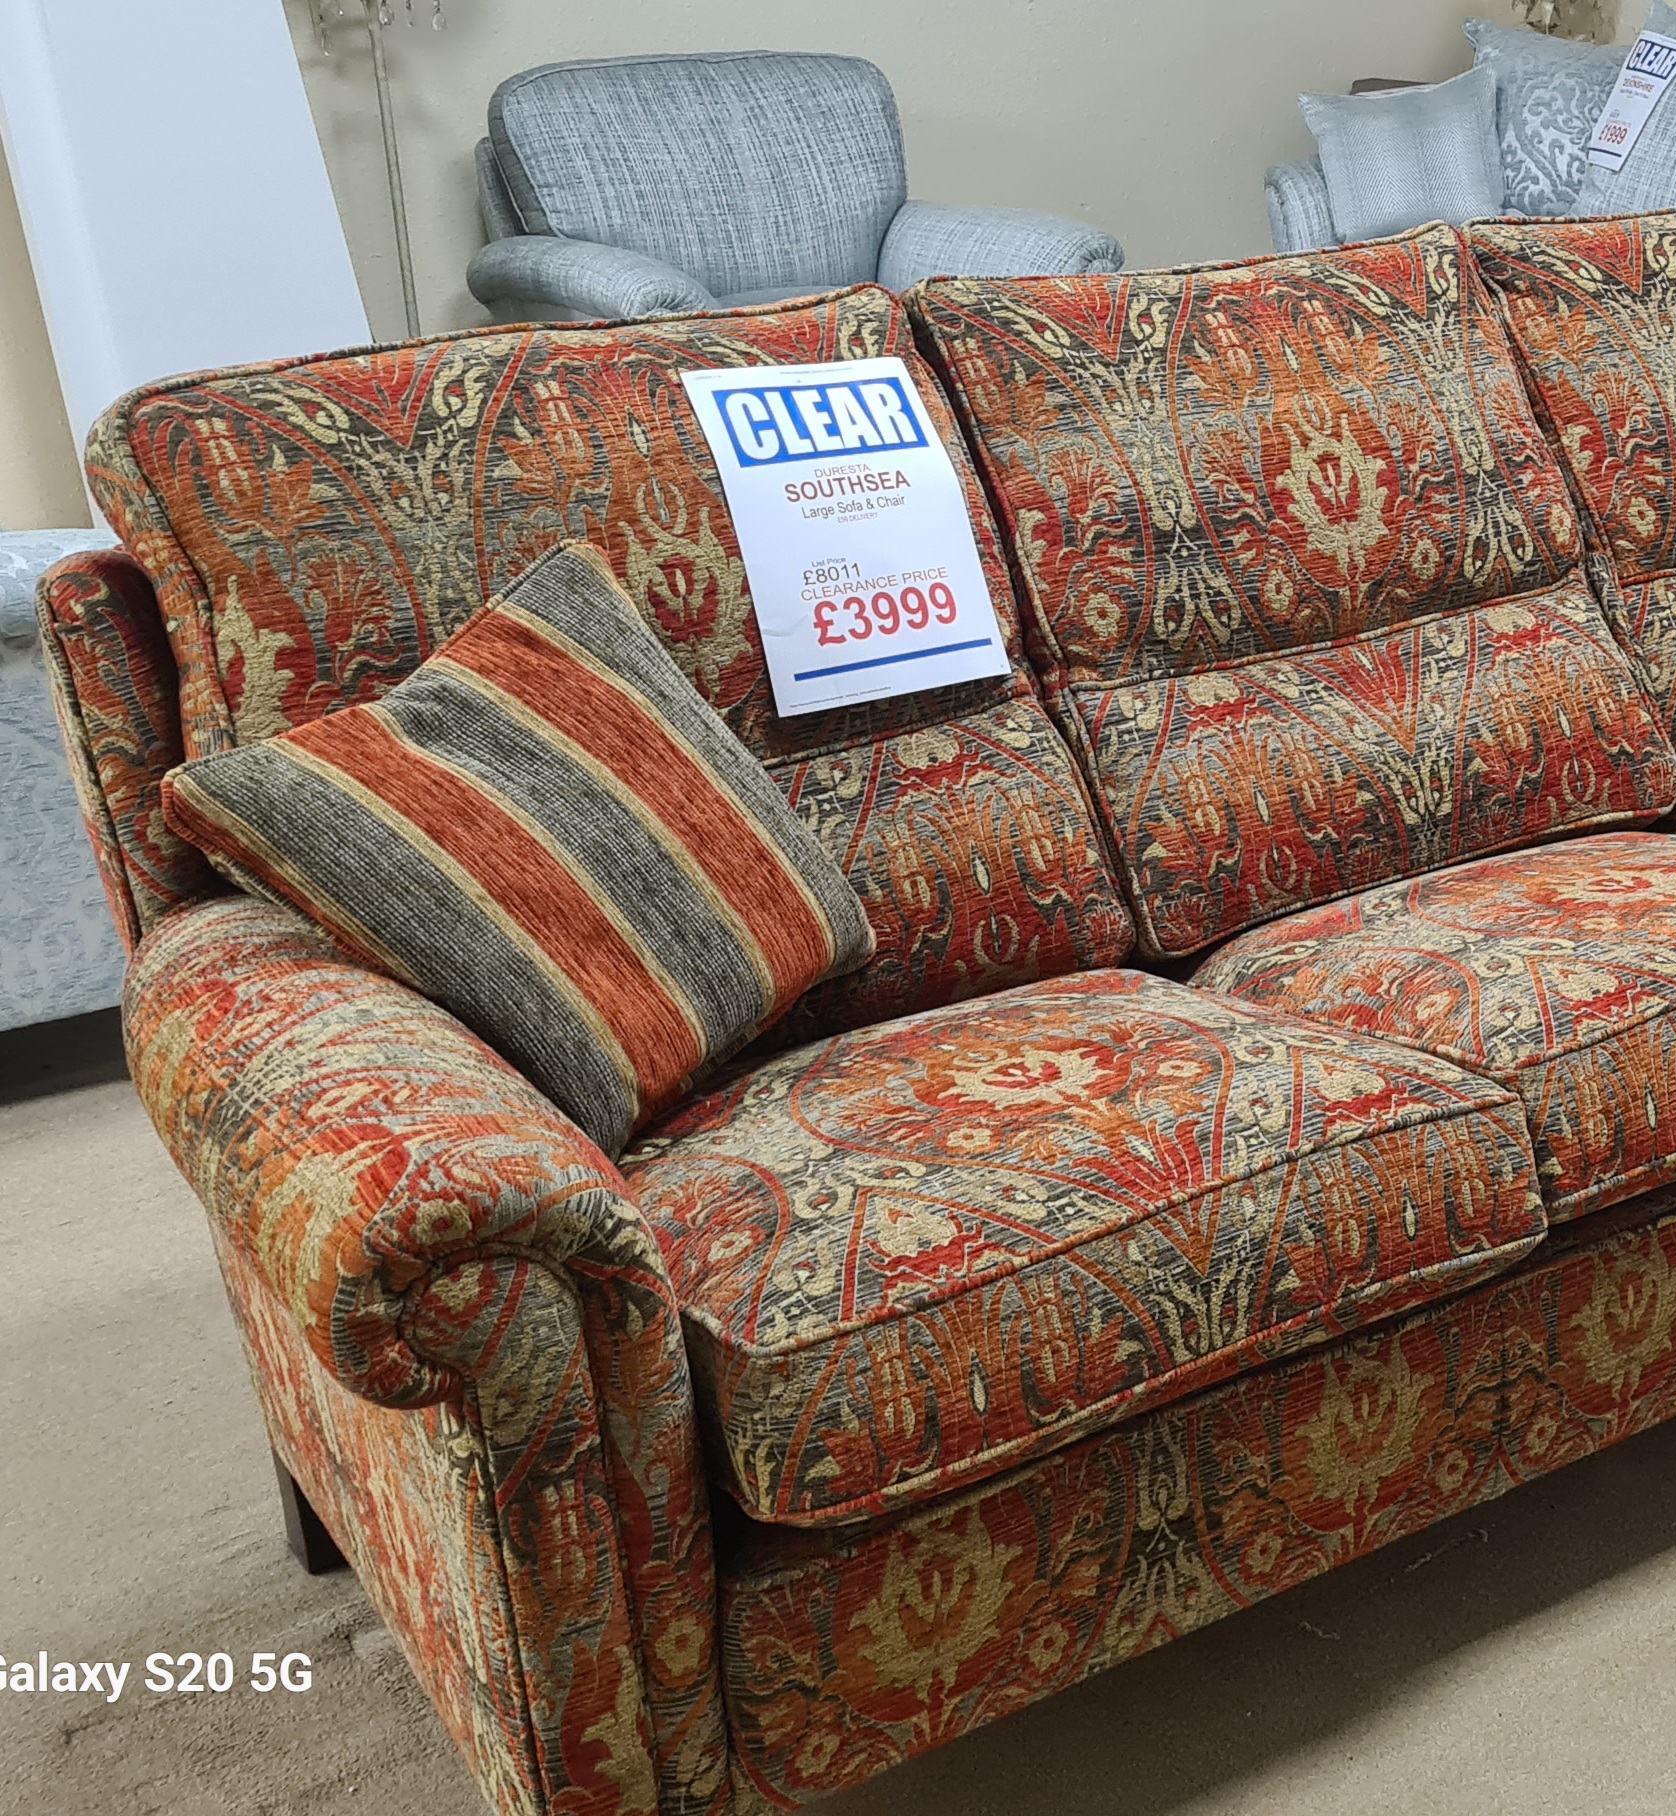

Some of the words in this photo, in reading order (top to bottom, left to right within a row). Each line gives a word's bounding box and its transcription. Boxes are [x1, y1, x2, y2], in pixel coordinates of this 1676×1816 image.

[725, 383, 919, 460] CLEAR
[814, 463, 872, 478] DURESTA
[784, 470, 911, 503] SOUTHSEA
[802, 505, 835, 519] Large
[837, 500, 863, 513] Sofa
[866, 498, 875, 510] &
[877, 494, 905, 509] Chair
[803, 562, 861, 586] £8011
[811, 559, 826, 568] List
[827, 557, 846, 566] Price
[801, 575, 898, 601] CLEARANCE
[902, 567, 948, 584] PRICE
[813, 582, 957, 646] £3999
